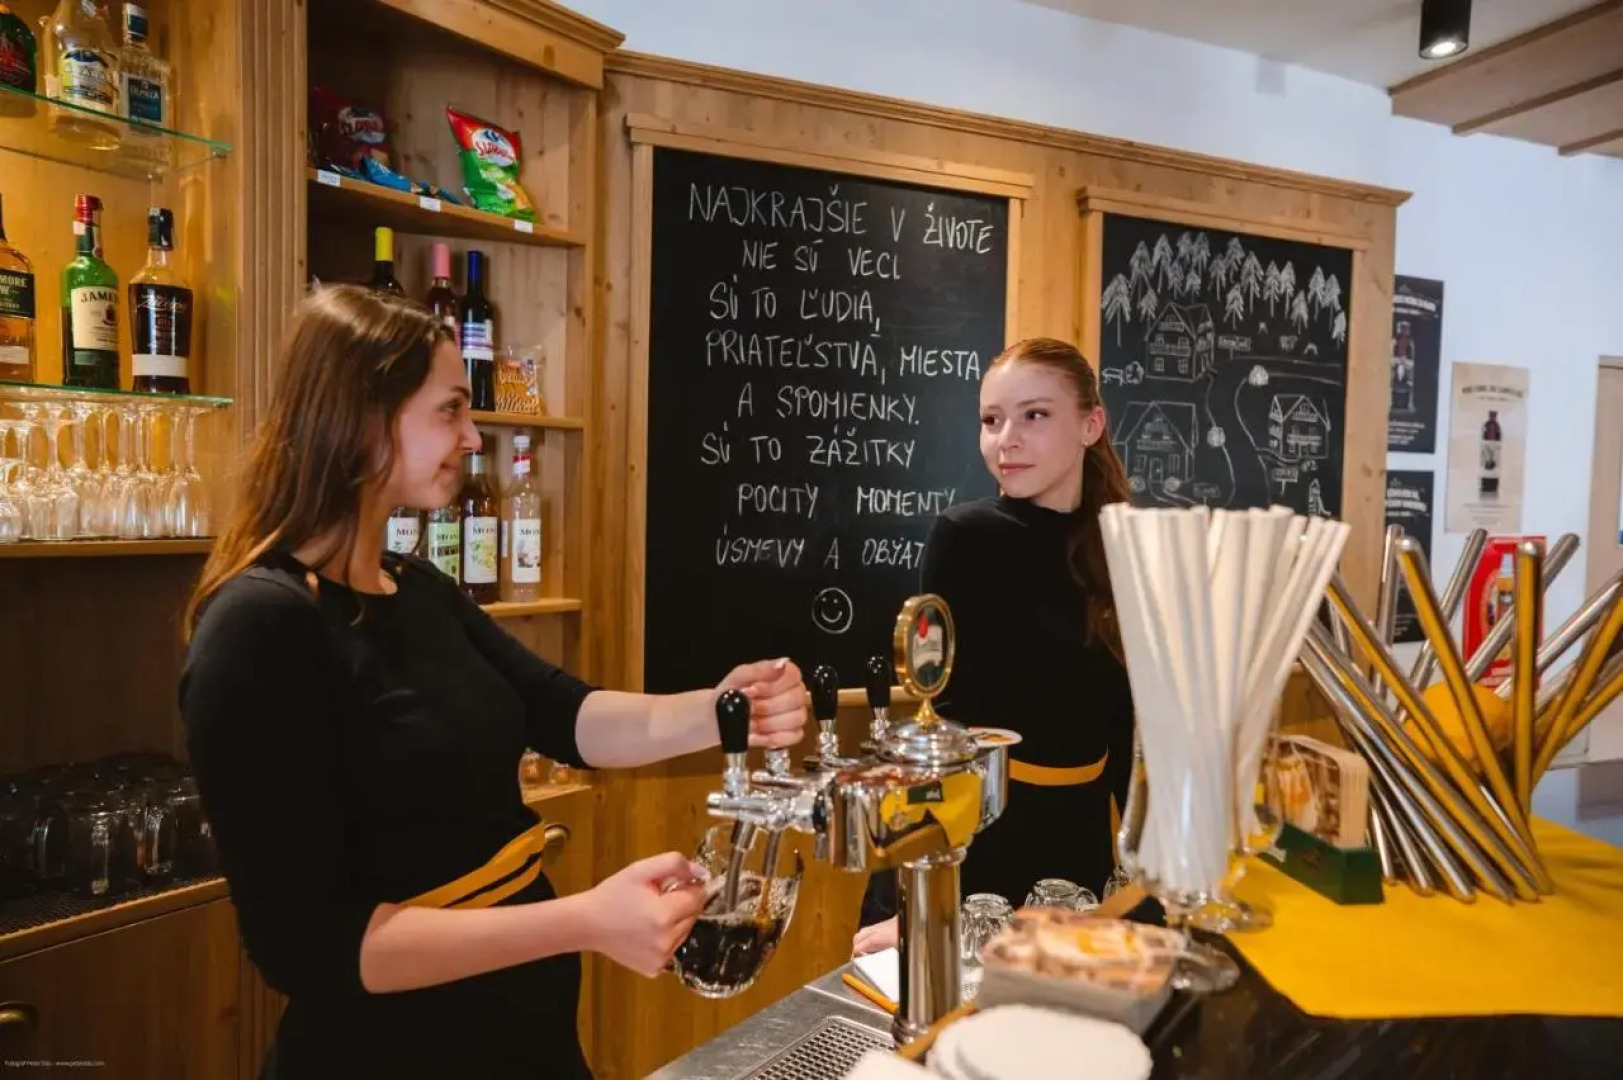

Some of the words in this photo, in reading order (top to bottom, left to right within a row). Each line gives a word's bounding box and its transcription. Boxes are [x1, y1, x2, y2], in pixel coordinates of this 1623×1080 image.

[689, 182, 868, 235] NAJKRAJŠIE
[891, 205, 906, 243] V
[923, 202, 994, 254] ŽIVOTE
[742, 240, 778, 270] NIE
[709, 274, 739, 320] SÚ
[751, 287, 777, 319] TO
[899, 345, 981, 381] MIESTA
[738, 382, 753, 418] A
[777, 385, 920, 426] SPOMIENKY.
[701, 421, 731, 465] SÚ
[751, 435, 782, 464] TO
[805, 425, 915, 469] ZÁŽITKY
[737, 483, 819, 519] POCITY
[856, 485, 956, 518] MOMENTY
[715, 523, 805, 569] ÚSMEVY
[823, 537, 840, 570] A
